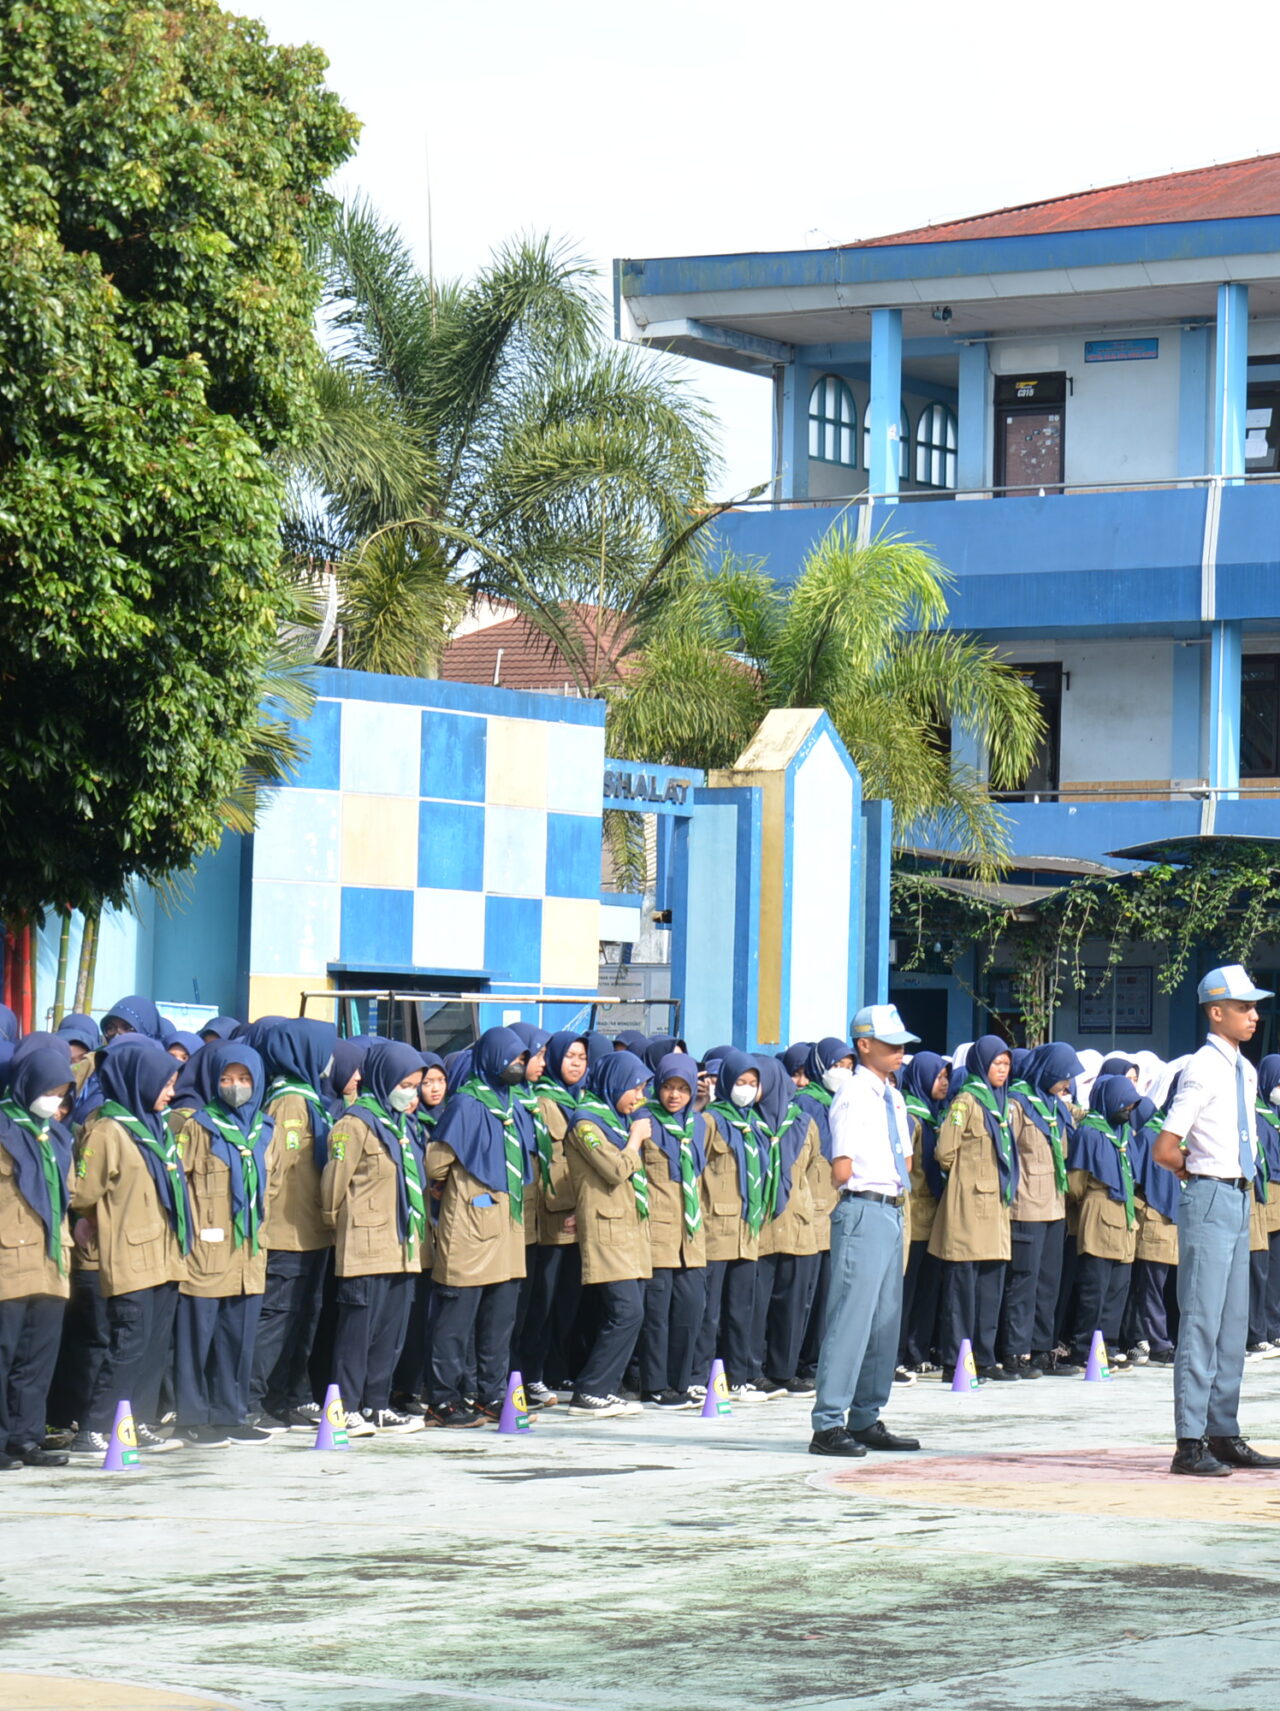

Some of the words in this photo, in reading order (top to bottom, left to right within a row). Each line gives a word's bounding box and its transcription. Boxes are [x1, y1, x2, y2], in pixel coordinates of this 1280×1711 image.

[604, 770, 691, 805] SHALAT
[518, 1395, 524, 1406] 1
[332, 1409, 340, 1421] 1
[123, 1427, 131, 1440] 1
